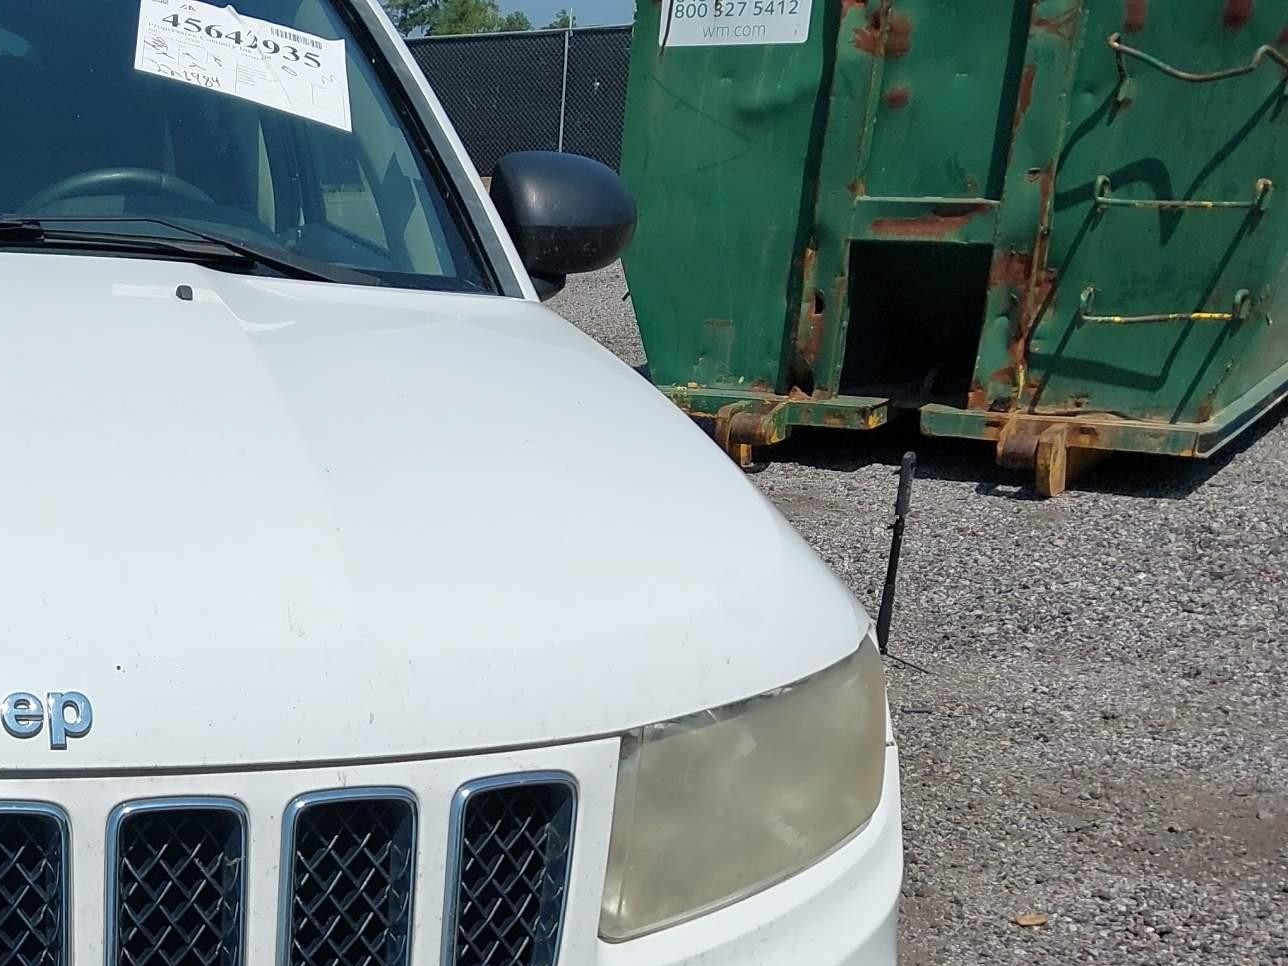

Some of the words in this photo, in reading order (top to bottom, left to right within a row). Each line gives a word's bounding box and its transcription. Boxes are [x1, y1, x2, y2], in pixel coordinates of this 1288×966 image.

[674, 3, 708, 18] 800
[753, 0, 799, 16] 5412
[703, 24, 766, 38] wm.com
[162, 13, 322, 70] 45642935
